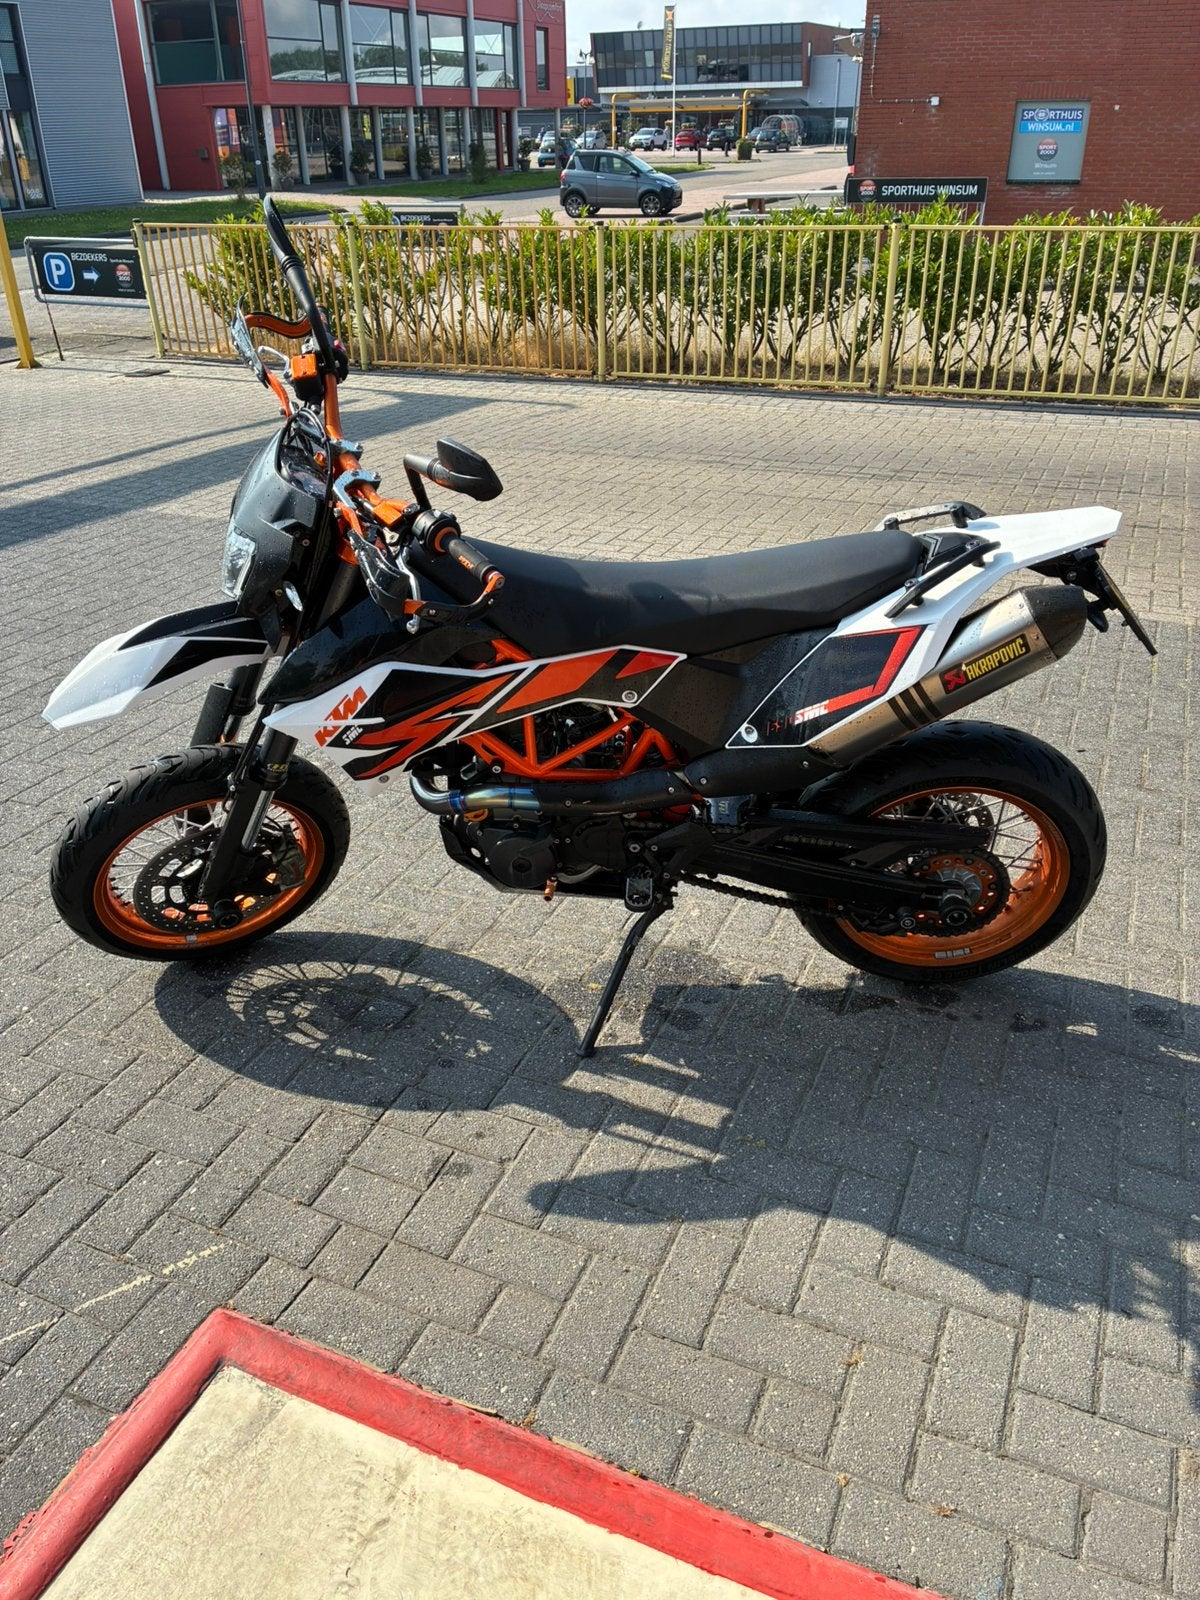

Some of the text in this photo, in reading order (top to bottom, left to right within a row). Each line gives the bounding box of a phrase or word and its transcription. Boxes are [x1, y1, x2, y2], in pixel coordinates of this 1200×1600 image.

[1023, 107, 1083, 121] SPORTHUIS
[1027, 122, 1074, 132] WINSUM.nl
[881, 185, 978, 196] SPORTHUIS WINSUM
[71, 252, 108, 262] BEZOEKERS
[49, 258, 66, 285] P
[314, 685, 368, 748] KTM
[794, 699, 830, 726] SMC
